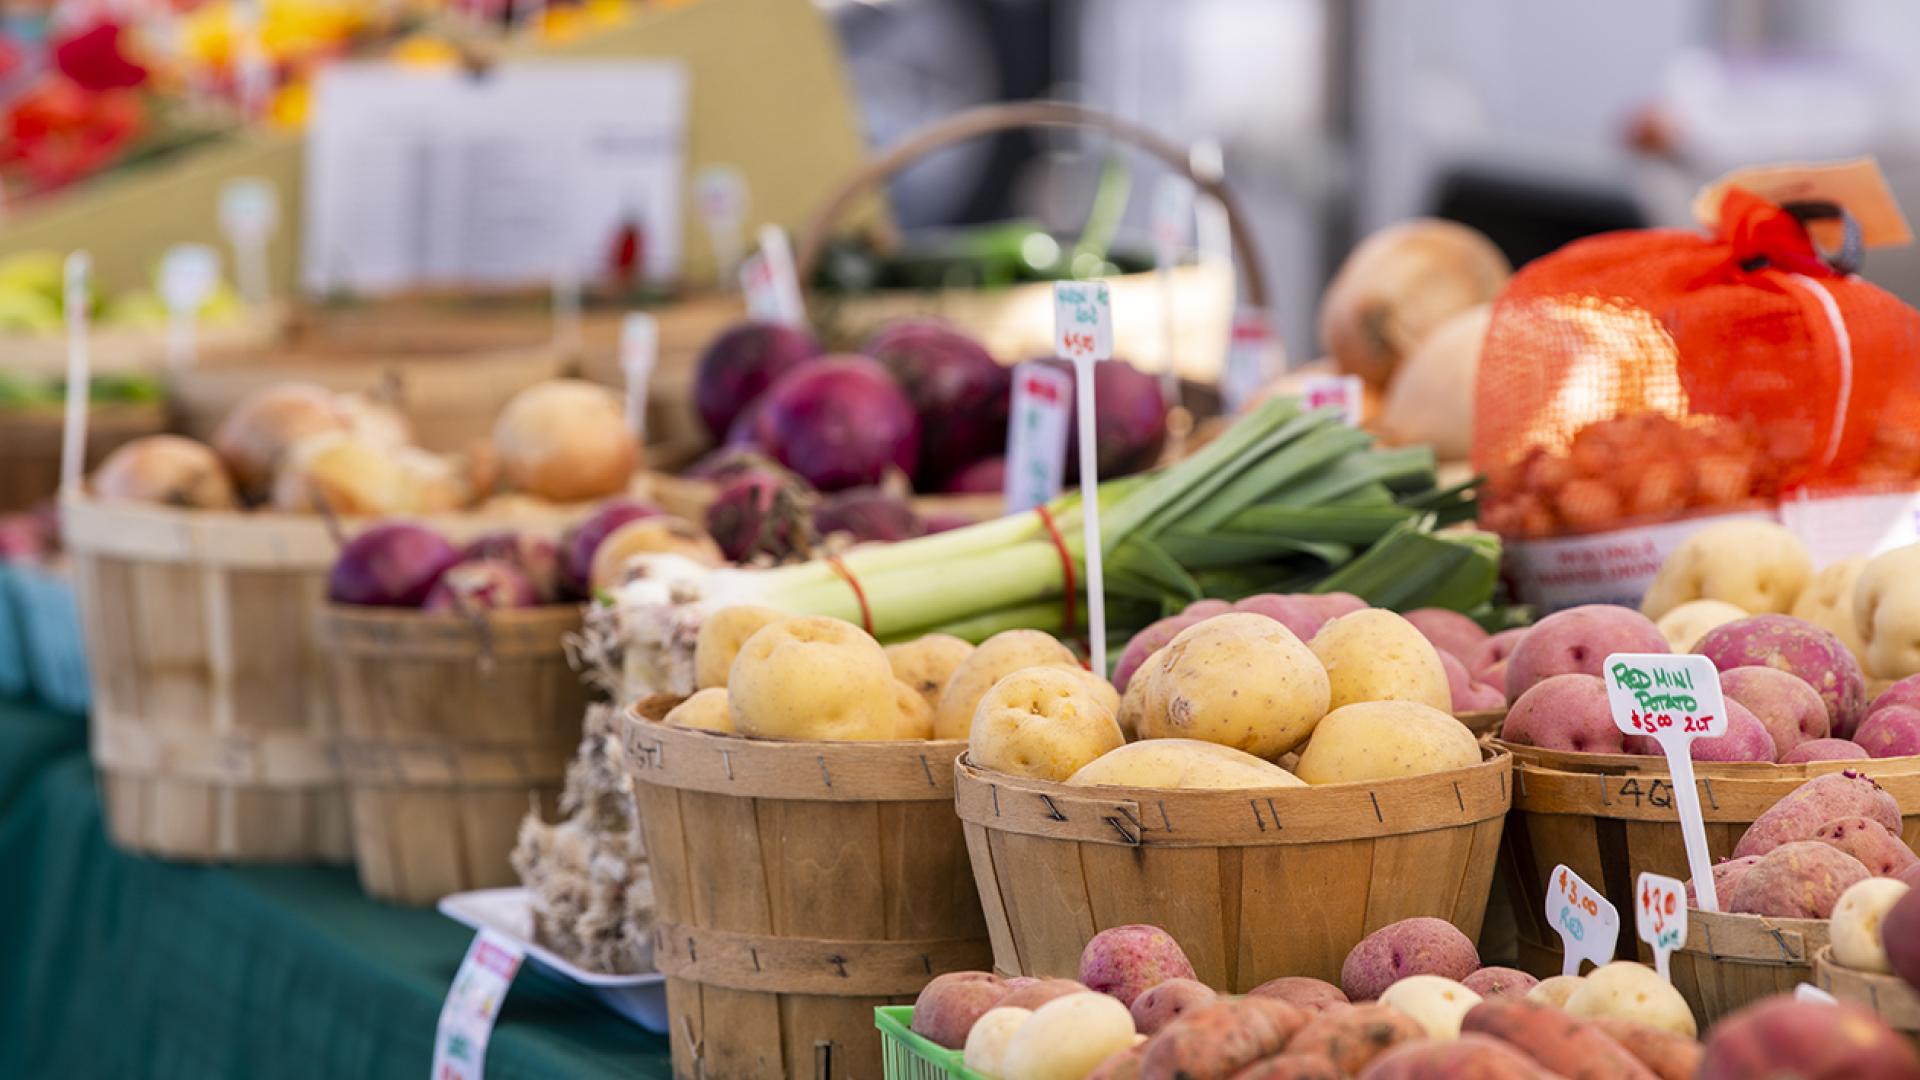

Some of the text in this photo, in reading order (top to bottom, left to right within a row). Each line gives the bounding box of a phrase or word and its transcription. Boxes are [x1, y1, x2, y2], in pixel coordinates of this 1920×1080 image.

[1611, 662, 1695, 691] RED MINI
[1634, 691, 1698, 713] POTATO
